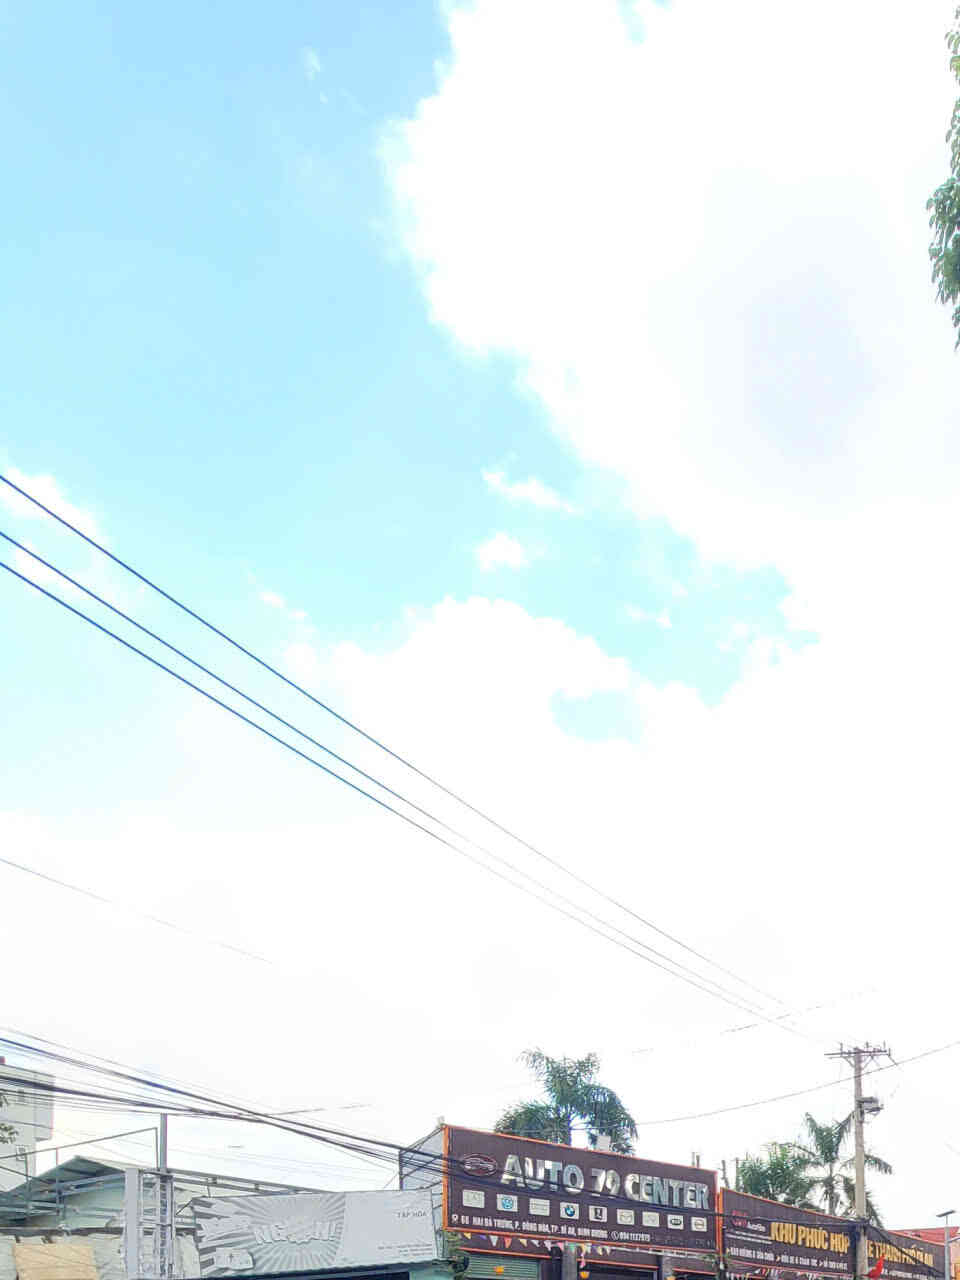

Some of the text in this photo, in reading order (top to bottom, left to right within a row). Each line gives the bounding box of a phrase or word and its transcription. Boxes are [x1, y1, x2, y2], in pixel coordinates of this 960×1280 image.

[500, 1153, 710, 1210] AUTO 79 CENTER
[770, 1221, 797, 1245] KHU
[797, 1225, 829, 1251] PHỨC
